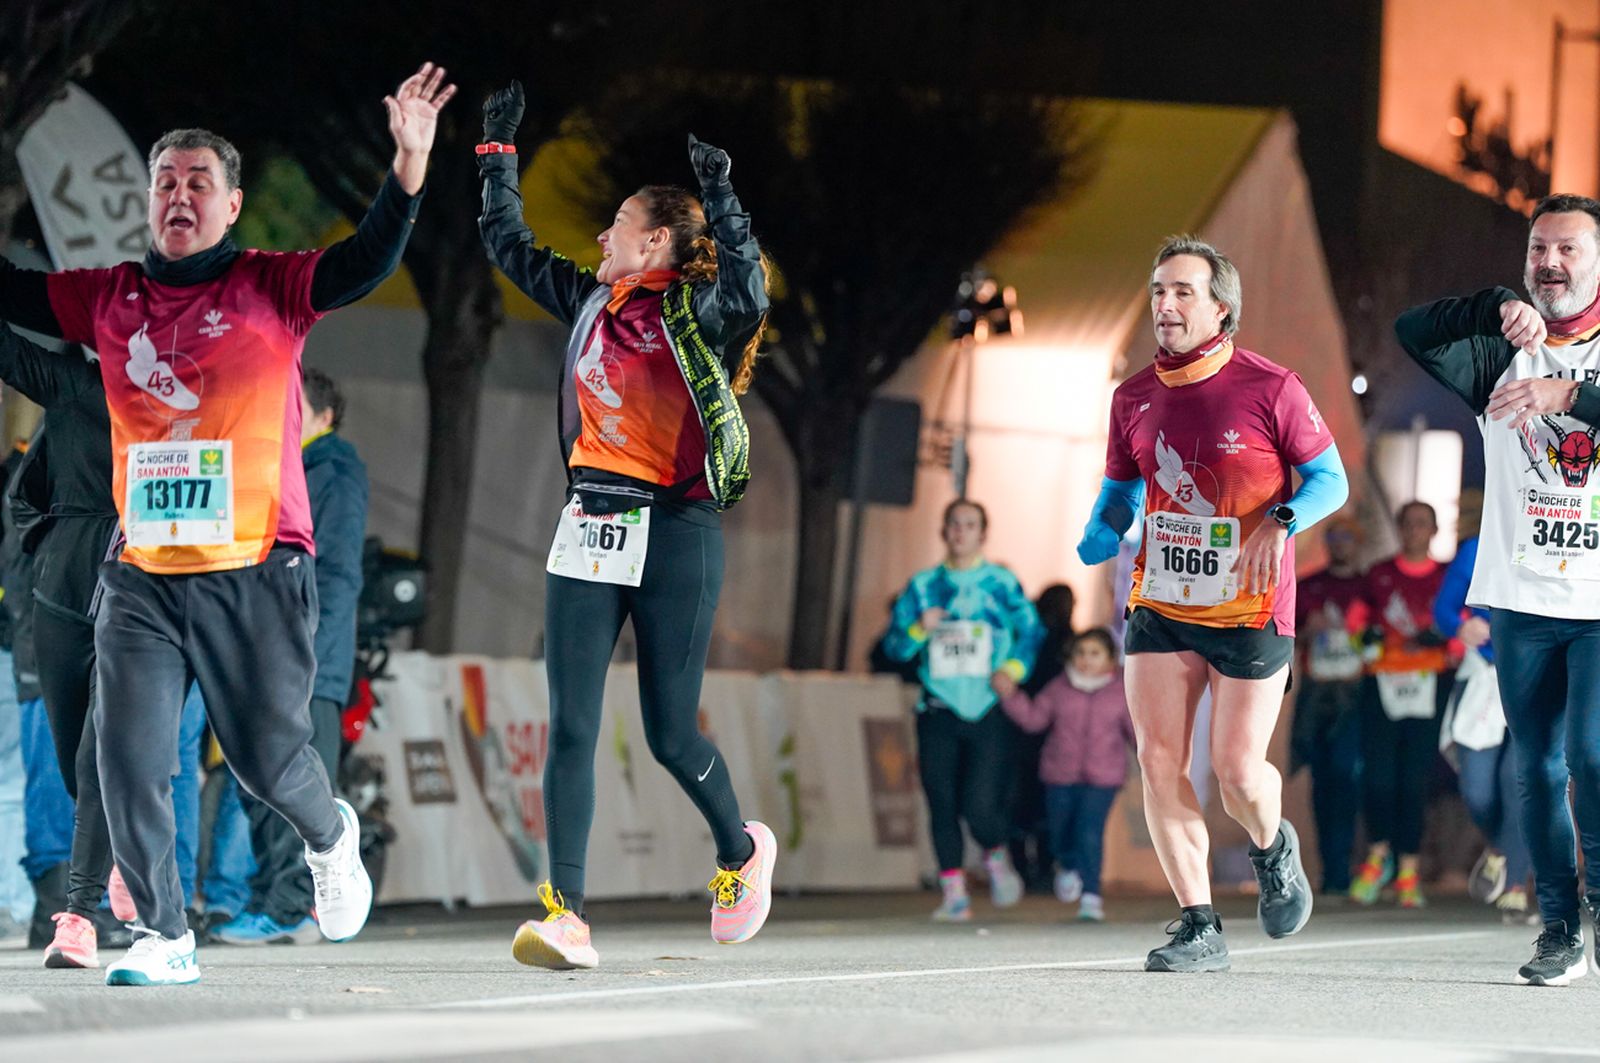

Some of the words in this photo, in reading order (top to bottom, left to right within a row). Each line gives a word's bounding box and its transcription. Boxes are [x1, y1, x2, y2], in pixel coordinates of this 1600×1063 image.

[147, 371, 175, 397] 43
[585, 368, 605, 392] 43
[147, 453, 171, 465] NOCHE
[176, 453, 189, 463] DE
[137, 467, 154, 478] SAN
[143, 479, 212, 510] 13177
[1538, 495, 1568, 507] NOCHE
[1570, 498, 1582, 507] DE
[1527, 505, 1546, 517] SAN
[579, 521, 627, 552] 1667
[1156, 531, 1171, 543] SAN
[1165, 522, 1190, 534] NOCHE
[1191, 525, 1202, 535] DE
[1533, 519, 1599, 550] 3425
[1161, 545, 1219, 576] 1666
